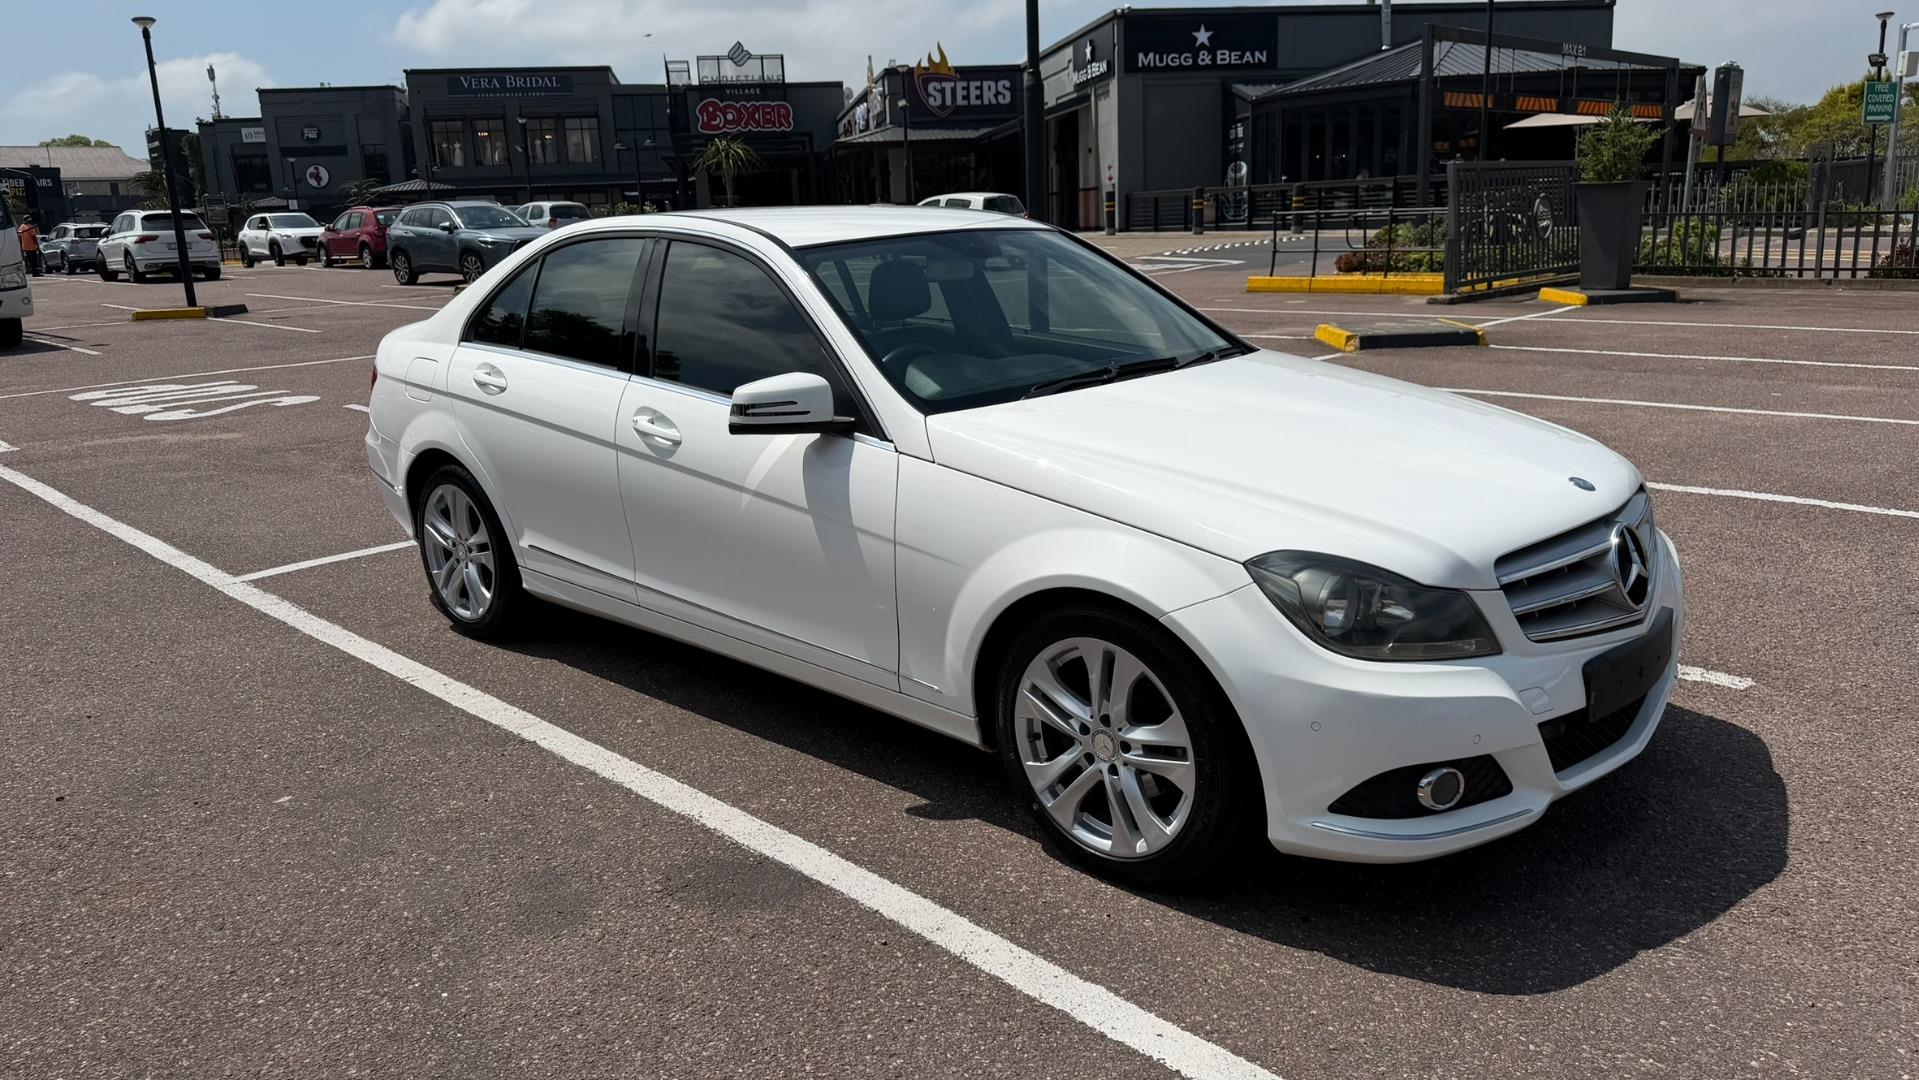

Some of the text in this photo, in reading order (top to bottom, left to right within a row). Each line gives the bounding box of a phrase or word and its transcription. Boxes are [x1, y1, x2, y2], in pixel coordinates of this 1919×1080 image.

[1562, 42, 1578, 56] MAX
[1138, 49, 1267, 67] MUGG & BEAN
[1092, 59, 1107, 78] BEAN
[460, 75, 560, 89] VERA BRIDAL
[1875, 83, 1889, 92] FREE
[725, 87, 761, 95] VILLAGE
[927, 79, 1012, 107] STEERS
[1867, 94, 1894, 103] COVERED
[696, 98, 793, 133] BOXER
[1867, 104, 1892, 113] PARKING
